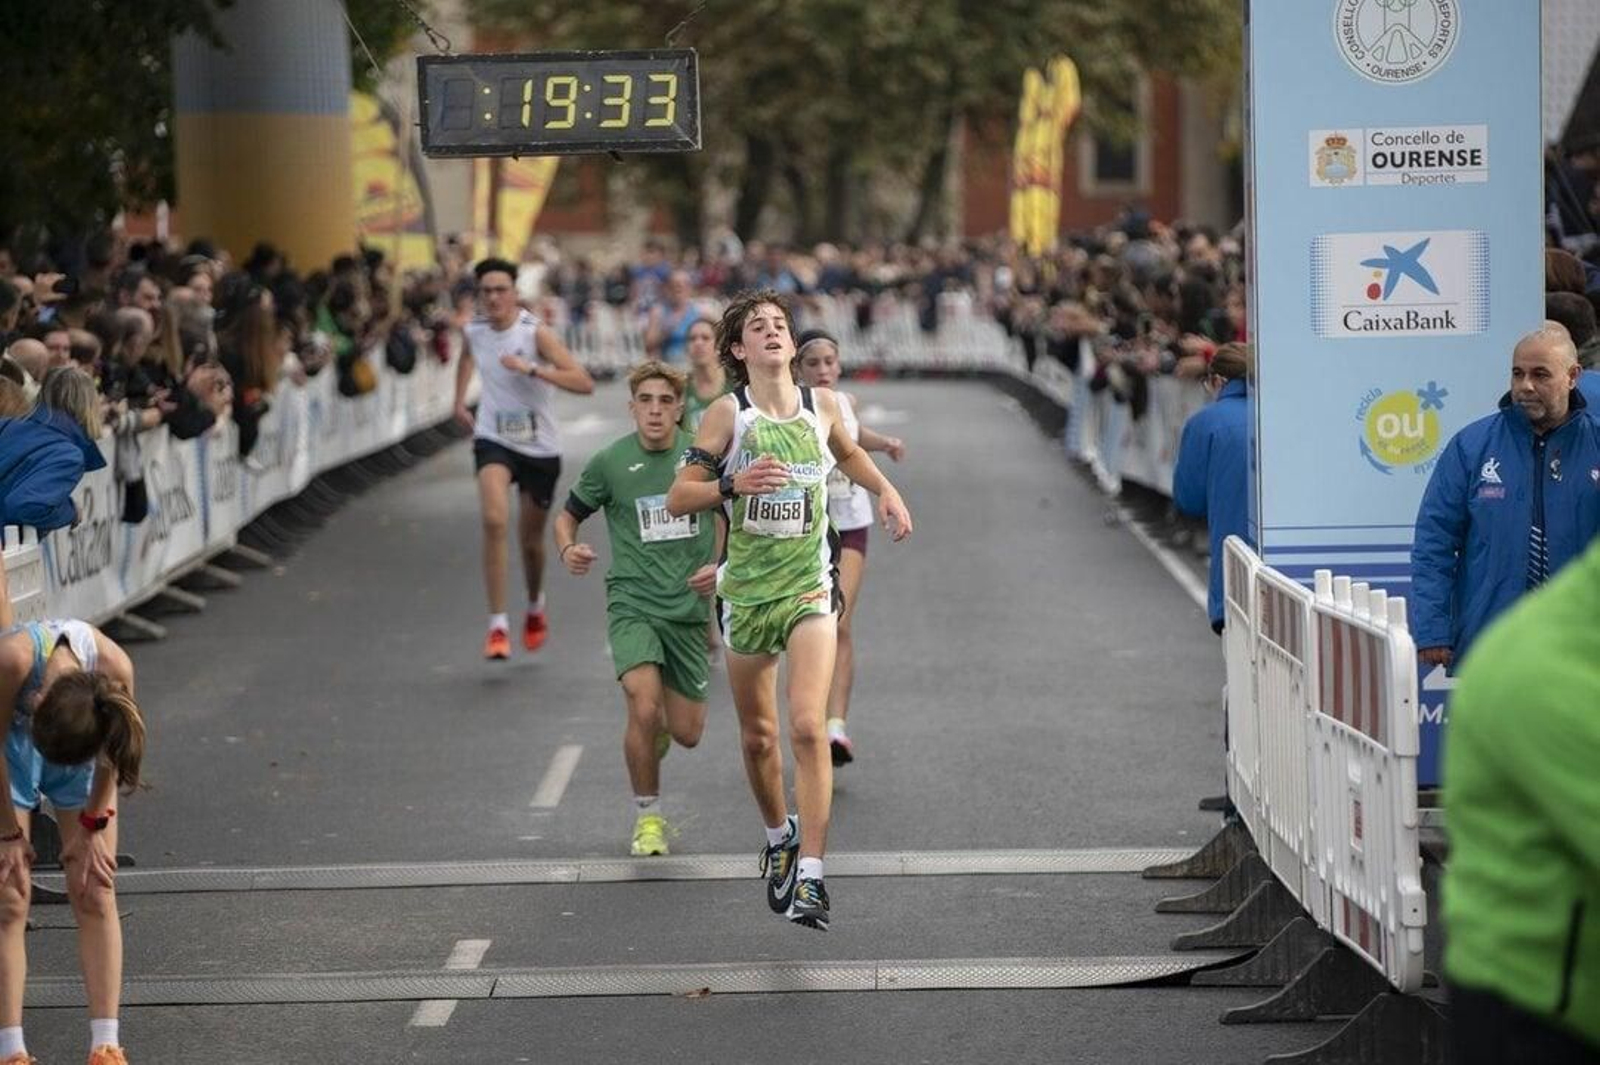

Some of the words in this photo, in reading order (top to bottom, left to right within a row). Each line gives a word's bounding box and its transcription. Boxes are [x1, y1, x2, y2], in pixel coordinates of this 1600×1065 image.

[1371, 63, 1420, 79] OURENSE
[1371, 130, 1440, 147] Concello
[1446, 130, 1465, 145] de
[1371, 149, 1482, 169] OURENSE
[1401, 172, 1456, 186] Deportes
[1343, 310, 1457, 332] CaixaBank
[1376, 413, 1425, 439] ou
[760, 502, 801, 520] 8058
